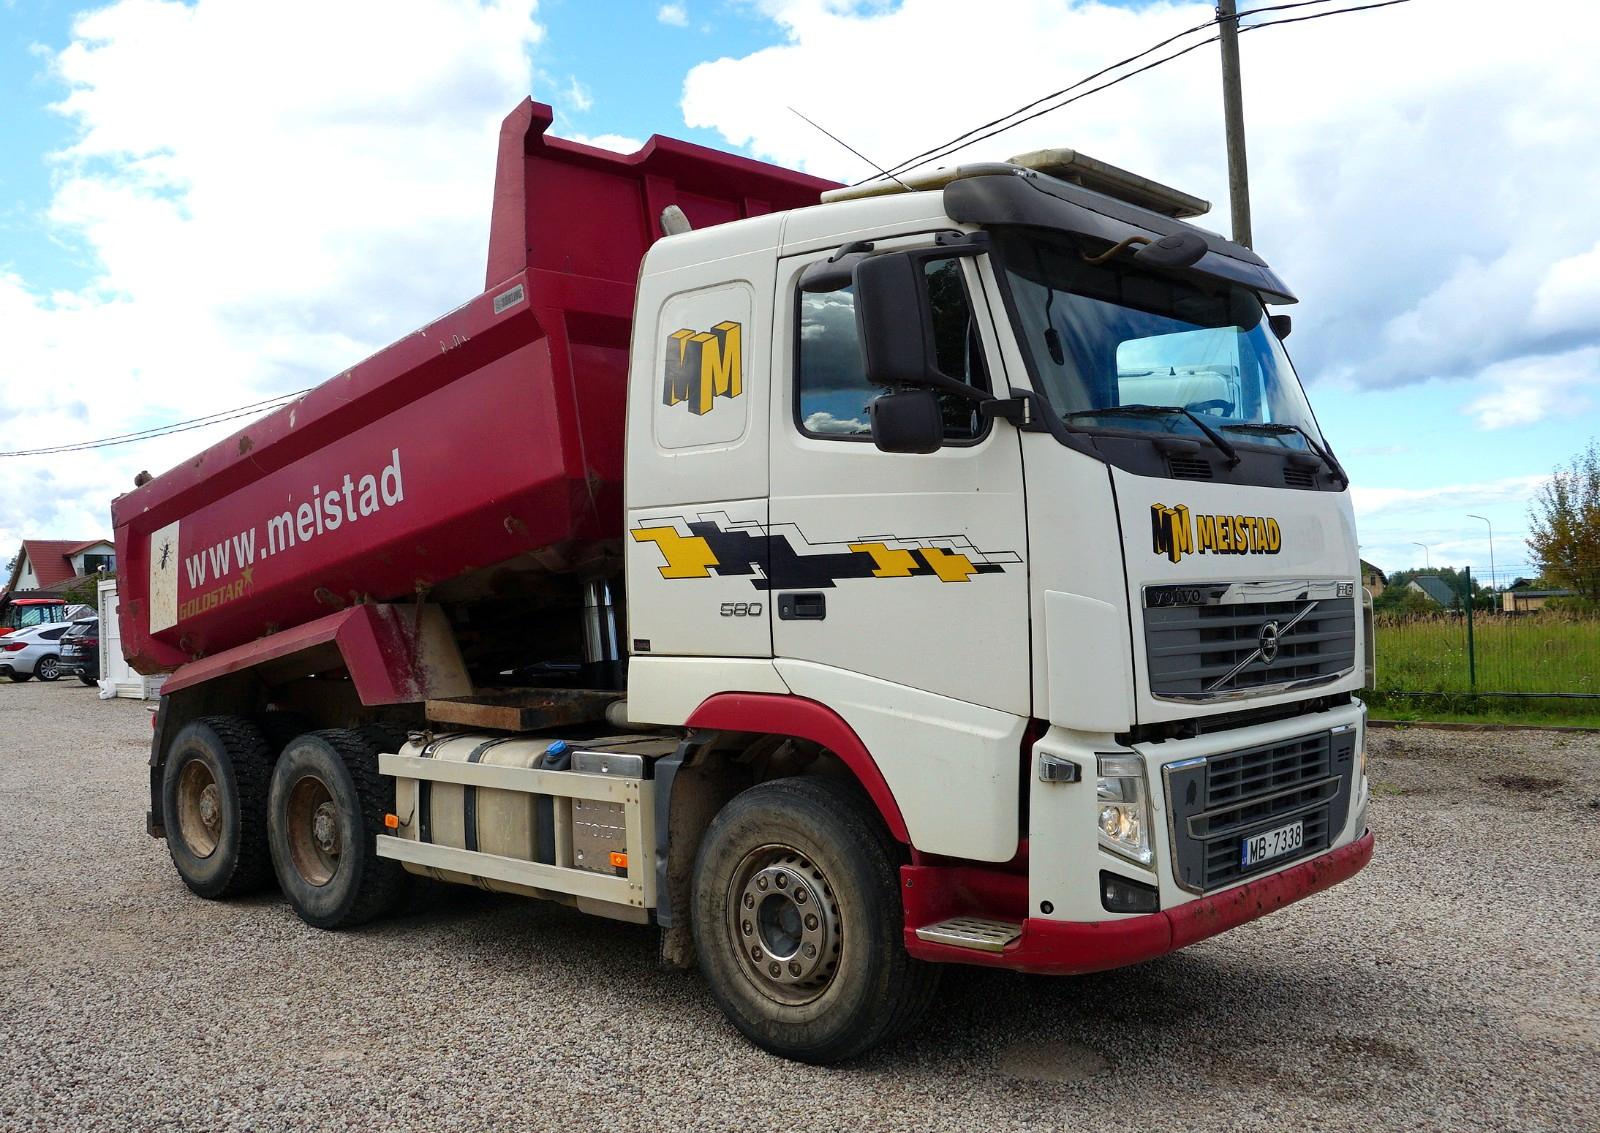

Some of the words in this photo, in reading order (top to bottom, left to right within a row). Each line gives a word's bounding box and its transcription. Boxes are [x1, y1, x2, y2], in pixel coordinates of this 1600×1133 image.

[663, 320, 743, 416] MM
[185, 447, 405, 590] www.meistad
[1196, 514, 1281, 555] MEISTAD
[178, 579, 245, 621] GOLDSTAR
[720, 602, 763, 617] 580
